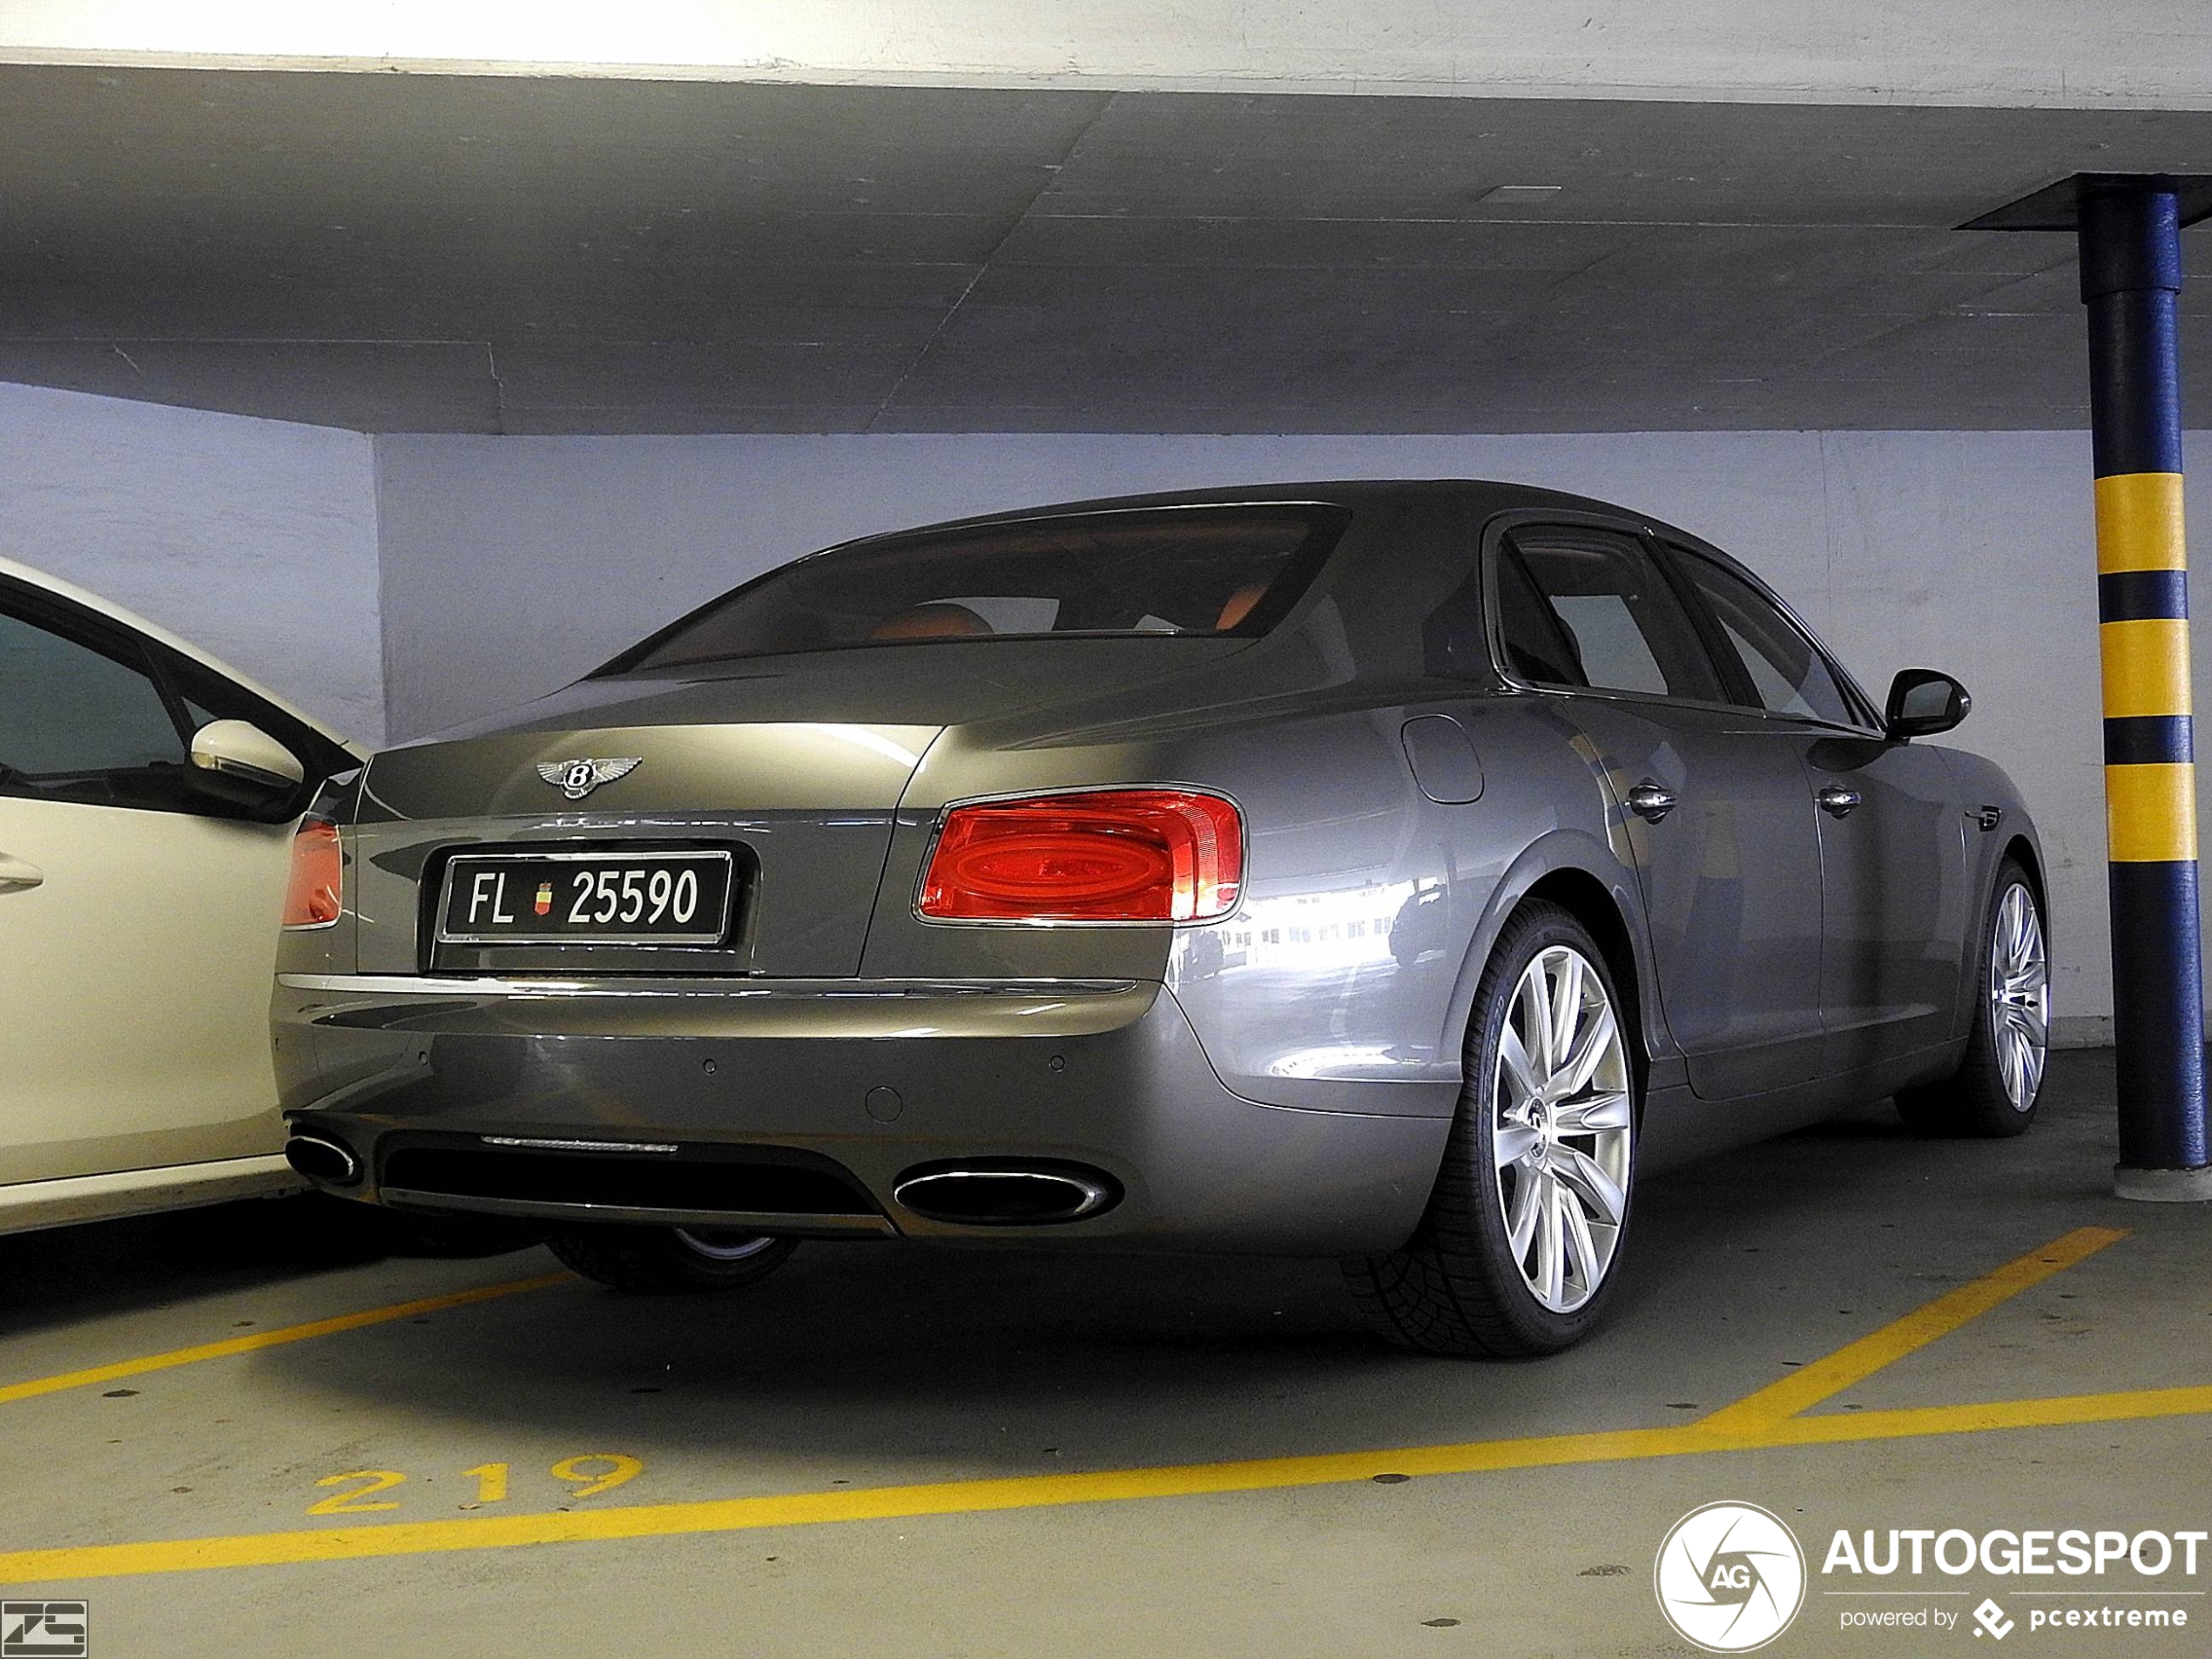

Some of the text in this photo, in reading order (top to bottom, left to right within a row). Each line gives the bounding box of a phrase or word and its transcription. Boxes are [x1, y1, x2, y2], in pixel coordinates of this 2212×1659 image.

[567, 764, 590, 787] B
[468, 868, 698, 925] FL 25590
[305, 1453, 644, 1516] 219
